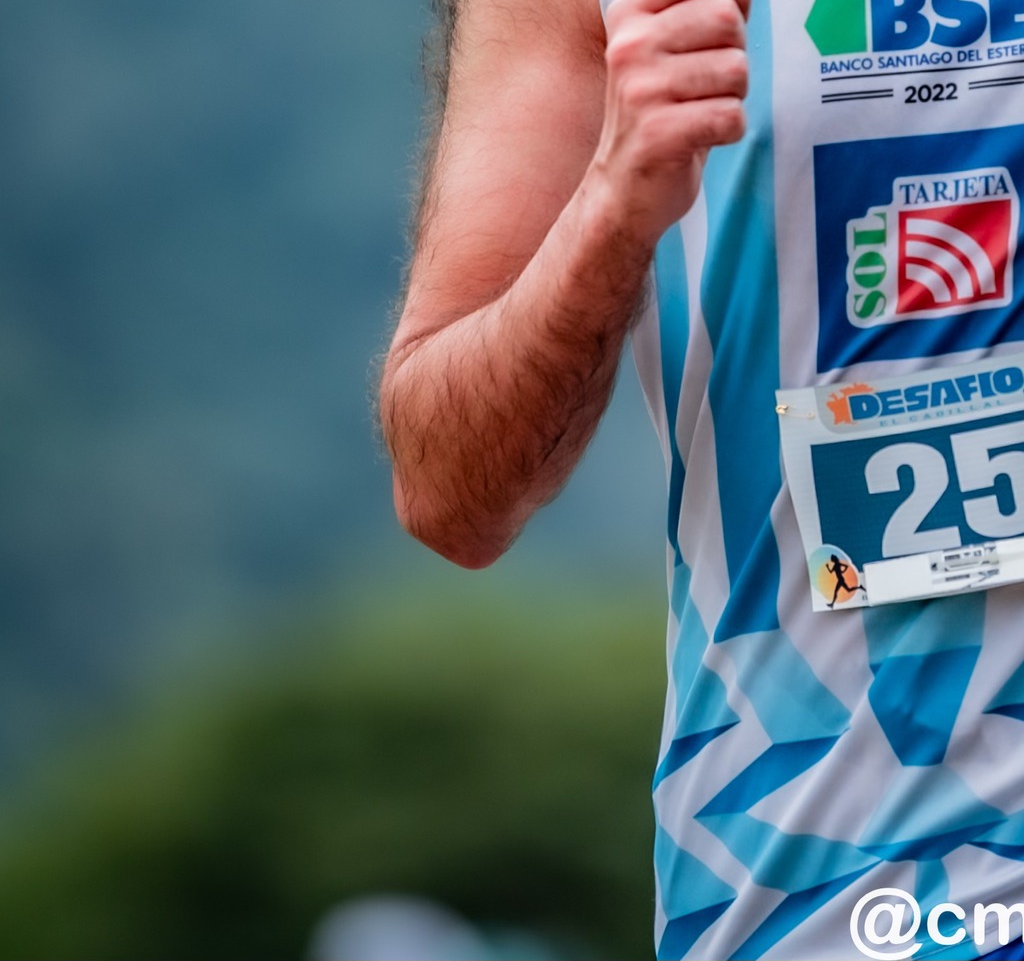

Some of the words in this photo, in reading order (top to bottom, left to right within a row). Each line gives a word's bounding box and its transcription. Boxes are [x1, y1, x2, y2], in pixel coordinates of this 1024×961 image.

[820, 57, 873, 74] BANCO
[878, 51, 953, 69] SANTIAGO
[957, 49, 983, 63] DEL
[904, 82, 958, 104] 2022
[900, 174, 1010, 205] TARJETA
[853, 212, 887, 320] SOL
[848, 366, 1024, 421] DESAFIO
